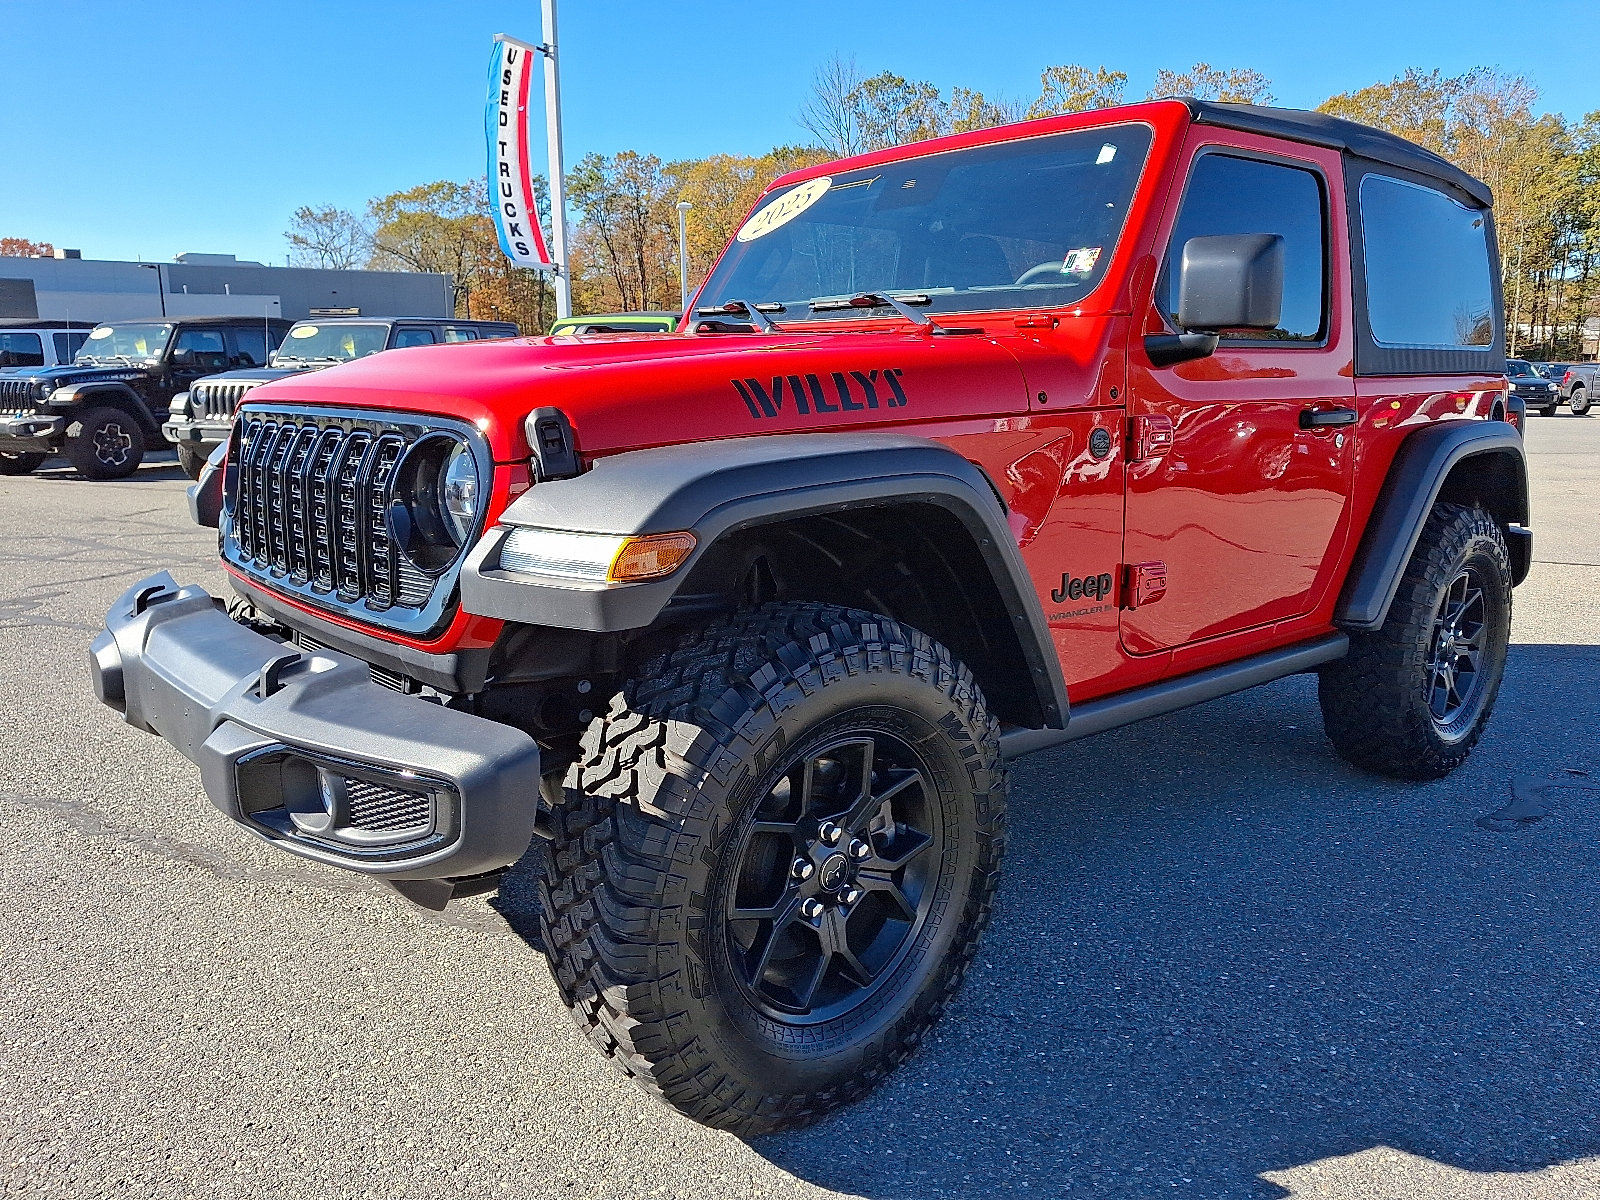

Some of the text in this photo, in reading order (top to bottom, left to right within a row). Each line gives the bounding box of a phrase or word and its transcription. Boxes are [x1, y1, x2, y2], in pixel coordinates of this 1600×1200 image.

[498, 47, 531, 257] USED TRUCKS
[730, 368, 908, 419] WILLYS
[1051, 572, 1112, 603] Jeep
[1049, 605, 1103, 621] WRANGLER
